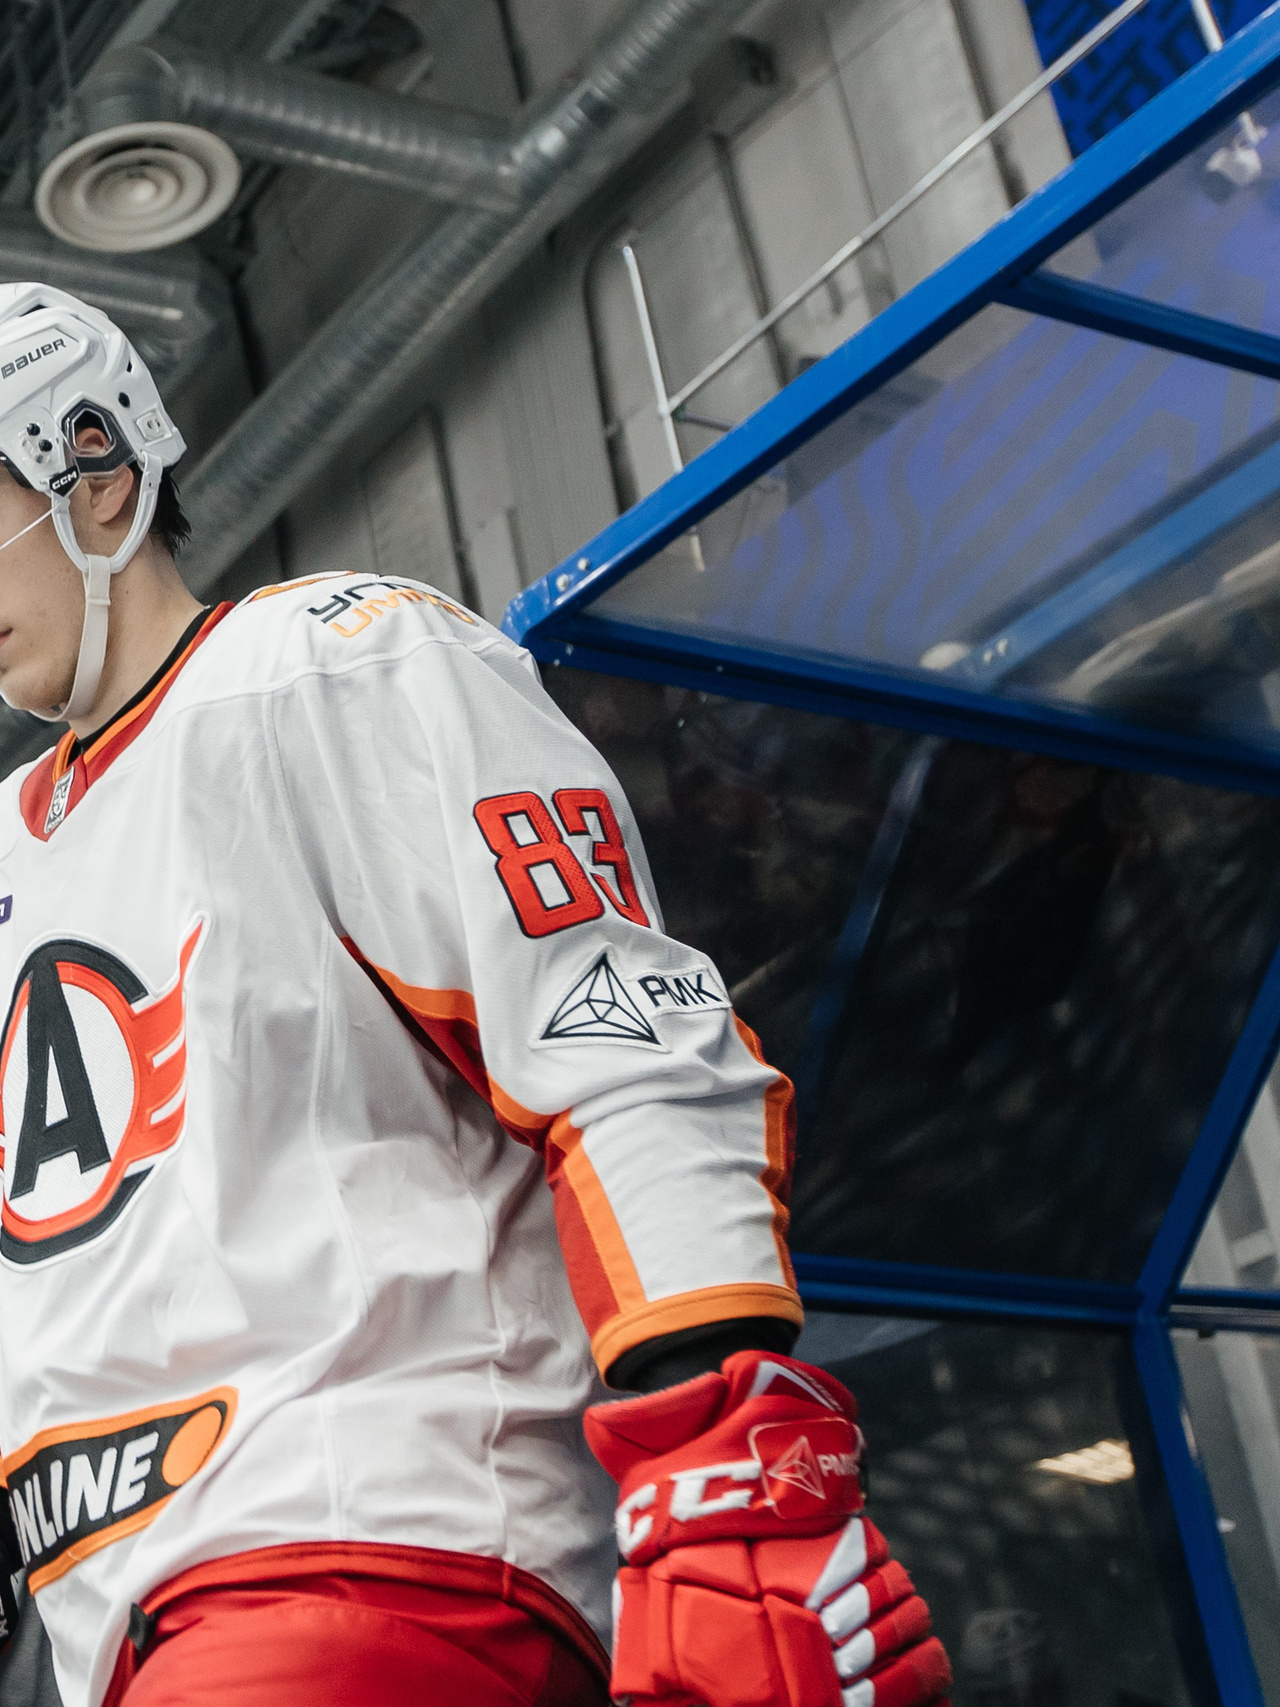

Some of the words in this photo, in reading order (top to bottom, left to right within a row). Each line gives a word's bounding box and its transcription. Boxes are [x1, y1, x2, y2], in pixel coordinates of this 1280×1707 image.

[51, 470, 77, 490] CCM
[473, 787, 652, 939] 83
[9, 1431, 160, 1566] NLINE
